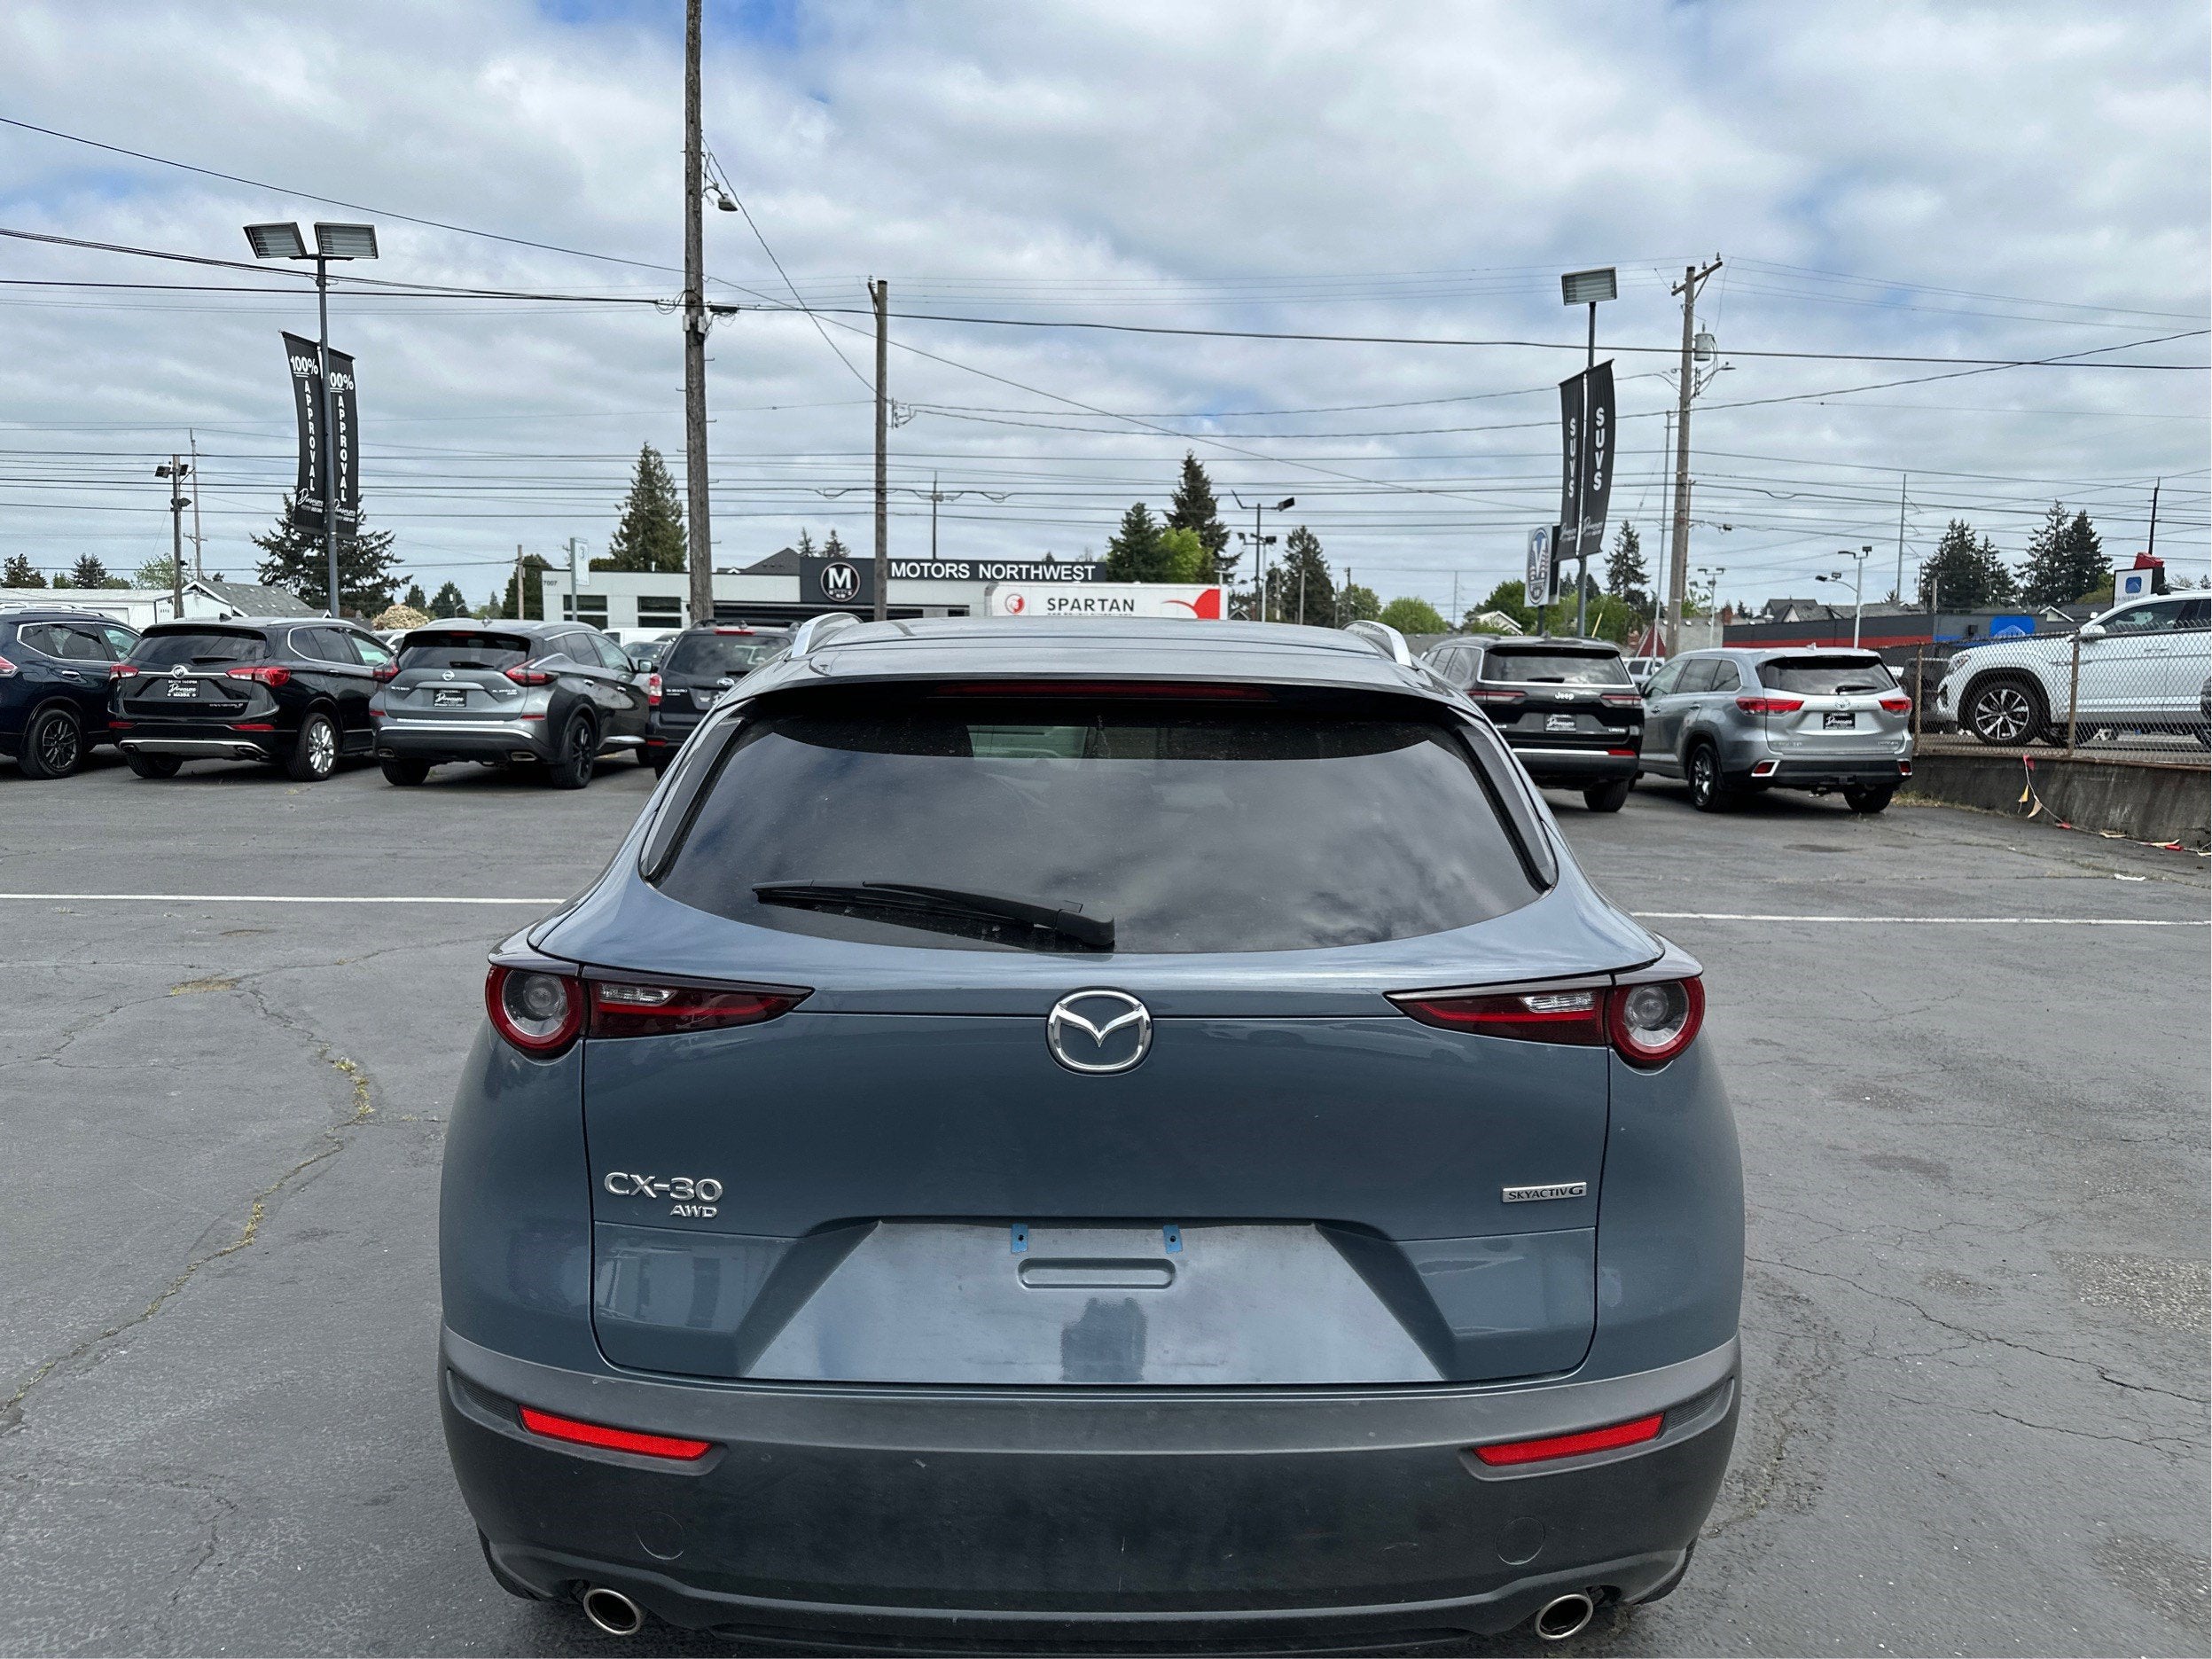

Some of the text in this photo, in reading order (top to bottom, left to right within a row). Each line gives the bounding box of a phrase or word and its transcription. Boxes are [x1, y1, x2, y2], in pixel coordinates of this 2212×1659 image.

[290, 356, 319, 375] 100%
[329, 372, 355, 390] 00%
[304, 380, 316, 491] APPROVAL
[338, 395, 348, 502] APPROVAL
[1593, 407, 1606, 491] SUVS
[828, 567, 852, 589] M
[891, 562, 1096, 581] MOTORS NORTHWEST
[1047, 598, 1135, 612] SPARTAN
[604, 1171, 723, 1203] CX-30
[669, 1204, 718, 1218] AWD
